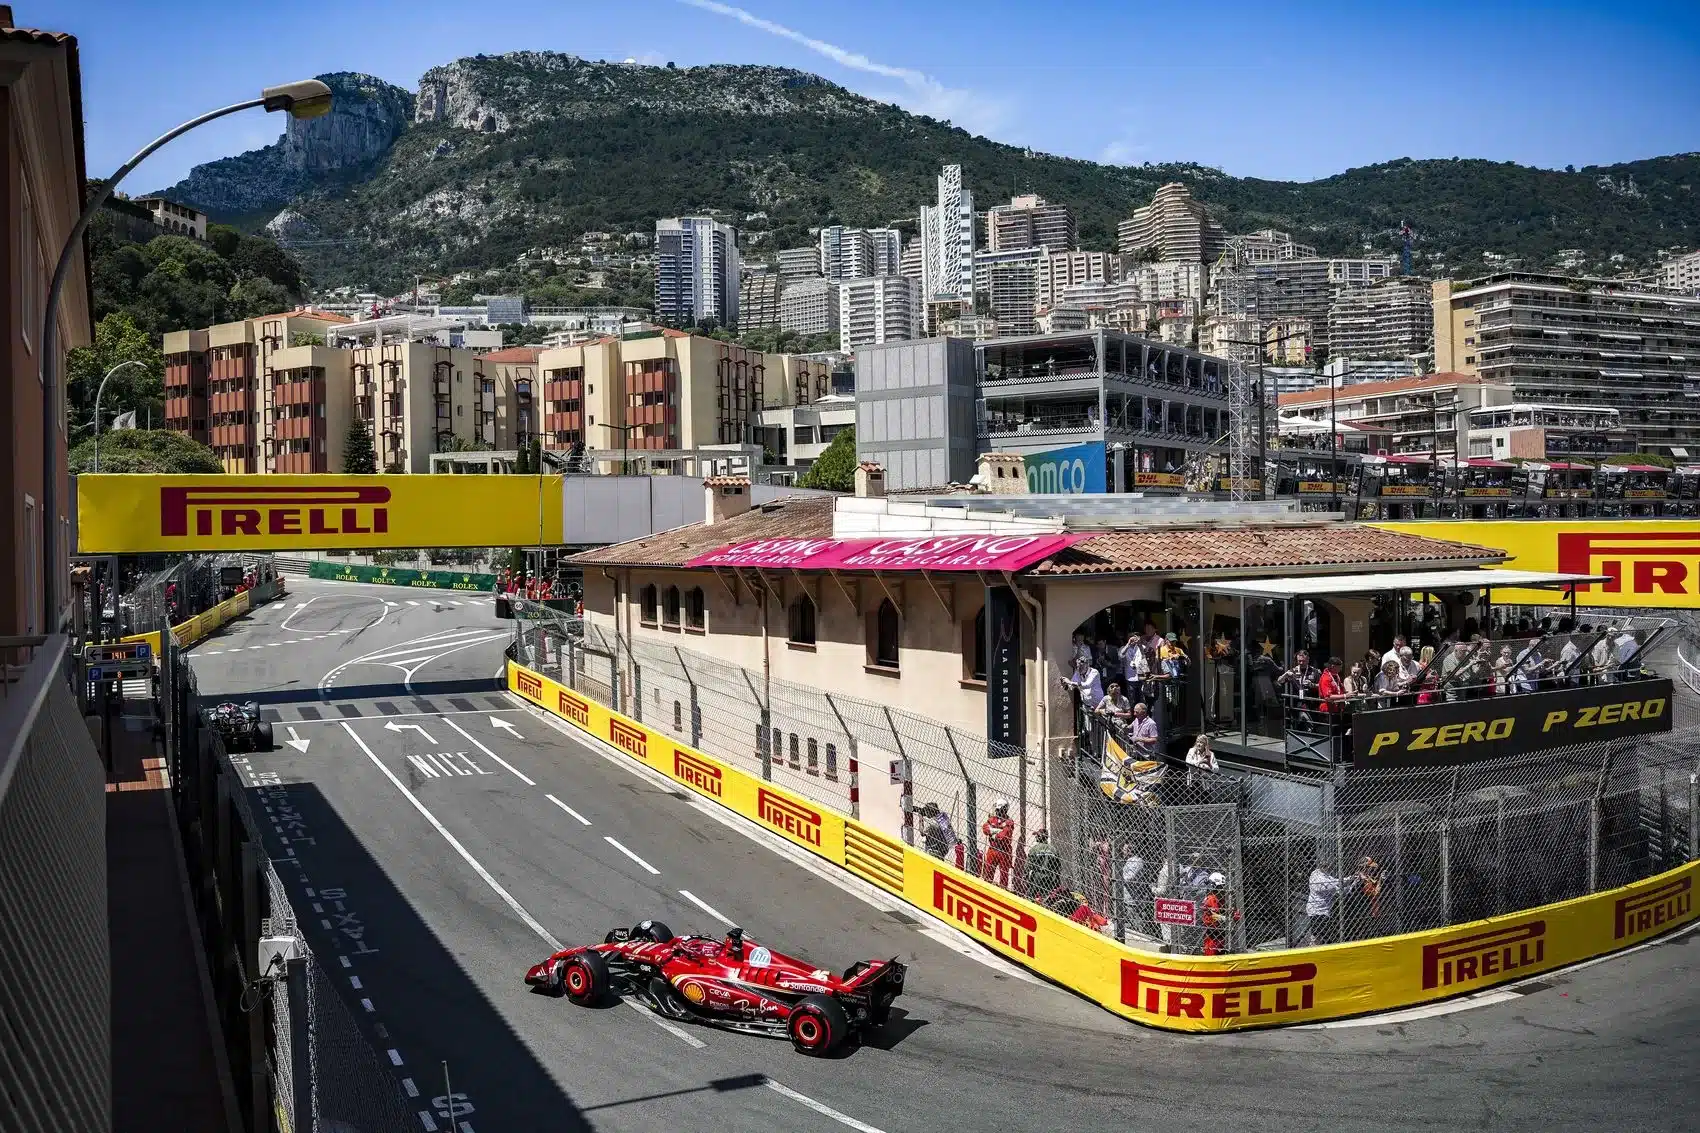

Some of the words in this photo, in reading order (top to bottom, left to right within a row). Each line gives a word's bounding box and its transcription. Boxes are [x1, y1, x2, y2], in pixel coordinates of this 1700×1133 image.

[1138, 474, 1159, 483] DHL
[161, 486, 391, 537] PIRELLI
[728, 538, 843, 556] CASINO
[869, 536, 1039, 556] CASINO
[335, 573, 359, 582] ROLEX
[1558, 532, 1700, 595] PIR
[372, 576, 396, 585] ROLEX
[411, 580, 437, 588] ROLEX
[140, 647, 146, 656] P
[1002, 648, 1008, 663] LA
[517, 670, 542, 701] PIRELLI
[559, 690, 589, 727] PIRELLI
[1542, 711, 1568, 732] P
[1574, 698, 1665, 729] ZERO
[610, 717, 647, 759] PIRELLI
[1368, 731, 1400, 756] P
[1407, 717, 1516, 751] ZERO
[406, 751, 494, 778] NICE
[674, 749, 723, 797] PIRELLI
[758, 787, 822, 847] PIRELLI
[933, 870, 1037, 959] PIRELLI
[1614, 876, 1692, 940] PIRELLI
[1422, 920, 1546, 991] PIRELLI
[709, 988, 731, 997] CEVA
[790, 982, 826, 994] Santander
[1120, 958, 1318, 1019] PIRELLI
[734, 998, 778, 1016] Ray-Ban
